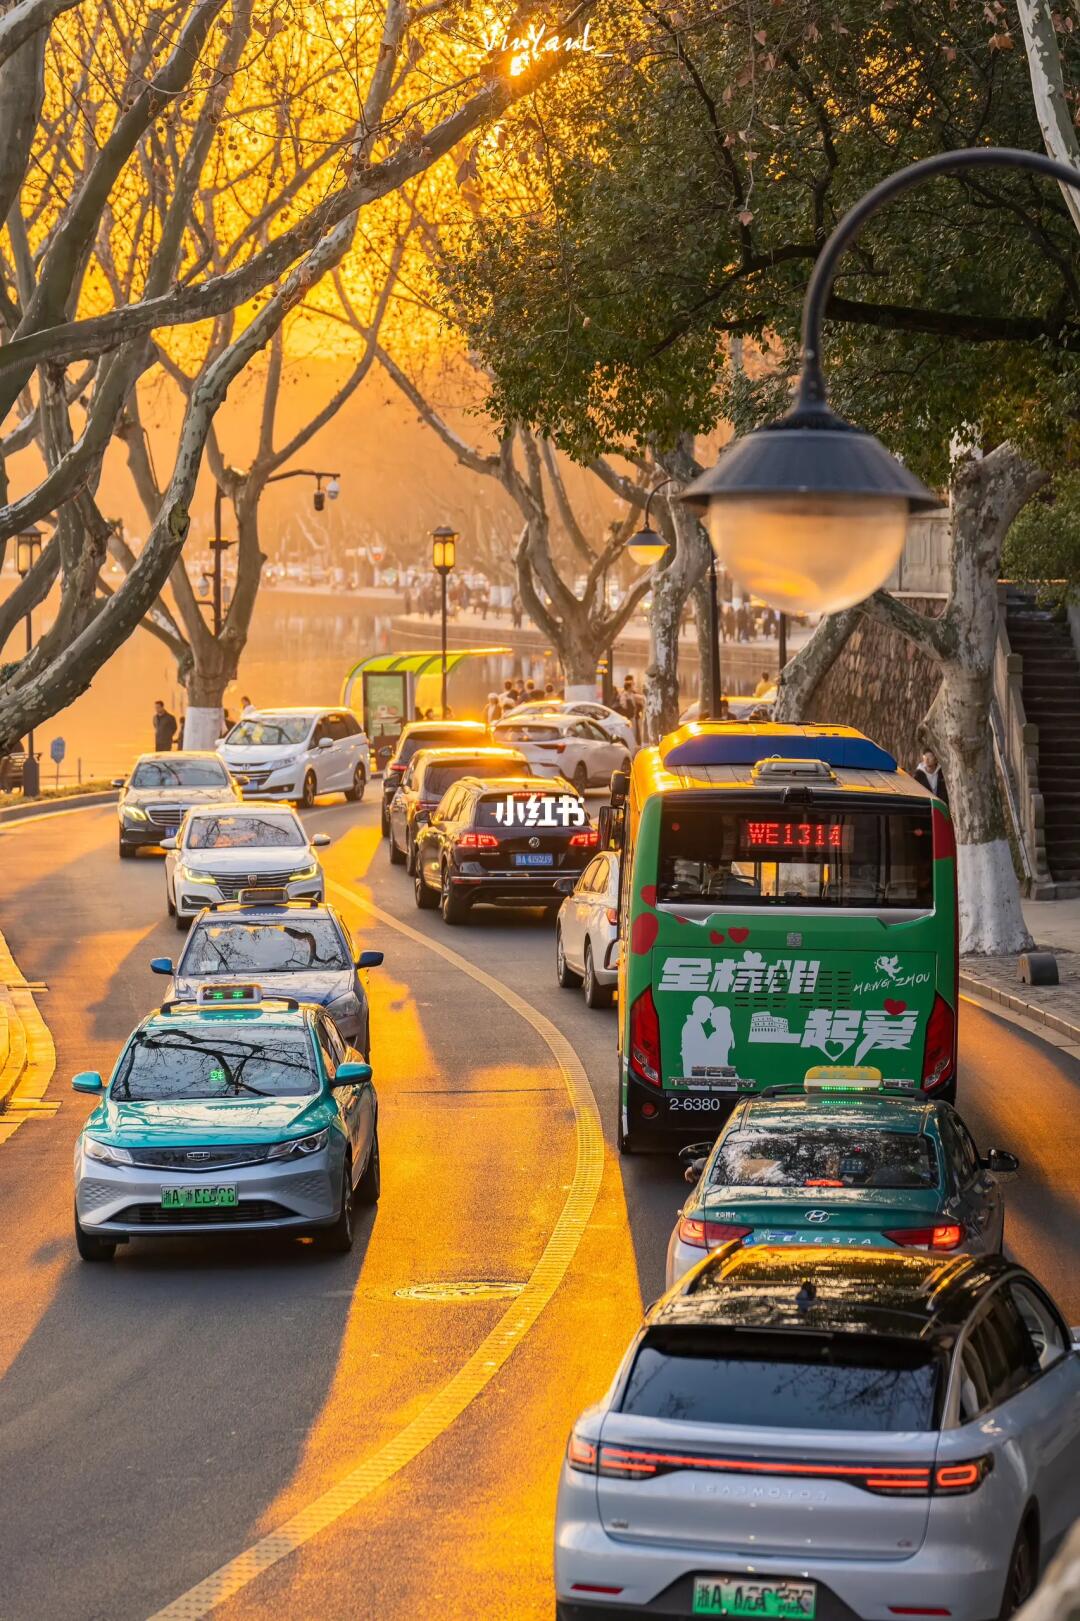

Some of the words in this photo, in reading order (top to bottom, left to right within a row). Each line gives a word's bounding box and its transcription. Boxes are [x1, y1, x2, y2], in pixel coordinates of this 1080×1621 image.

[749, 823, 841, 846] WE1314
[658, 950, 820, 994] 全杭州
[853, 979, 891, 996] HANG
[895, 972, 931, 988] ZHOU
[748, 1008, 919, 1067] 一起爱
[669, 1098, 720, 1111] 2-6380
[767, 1233, 872, 1245] CELESTA
